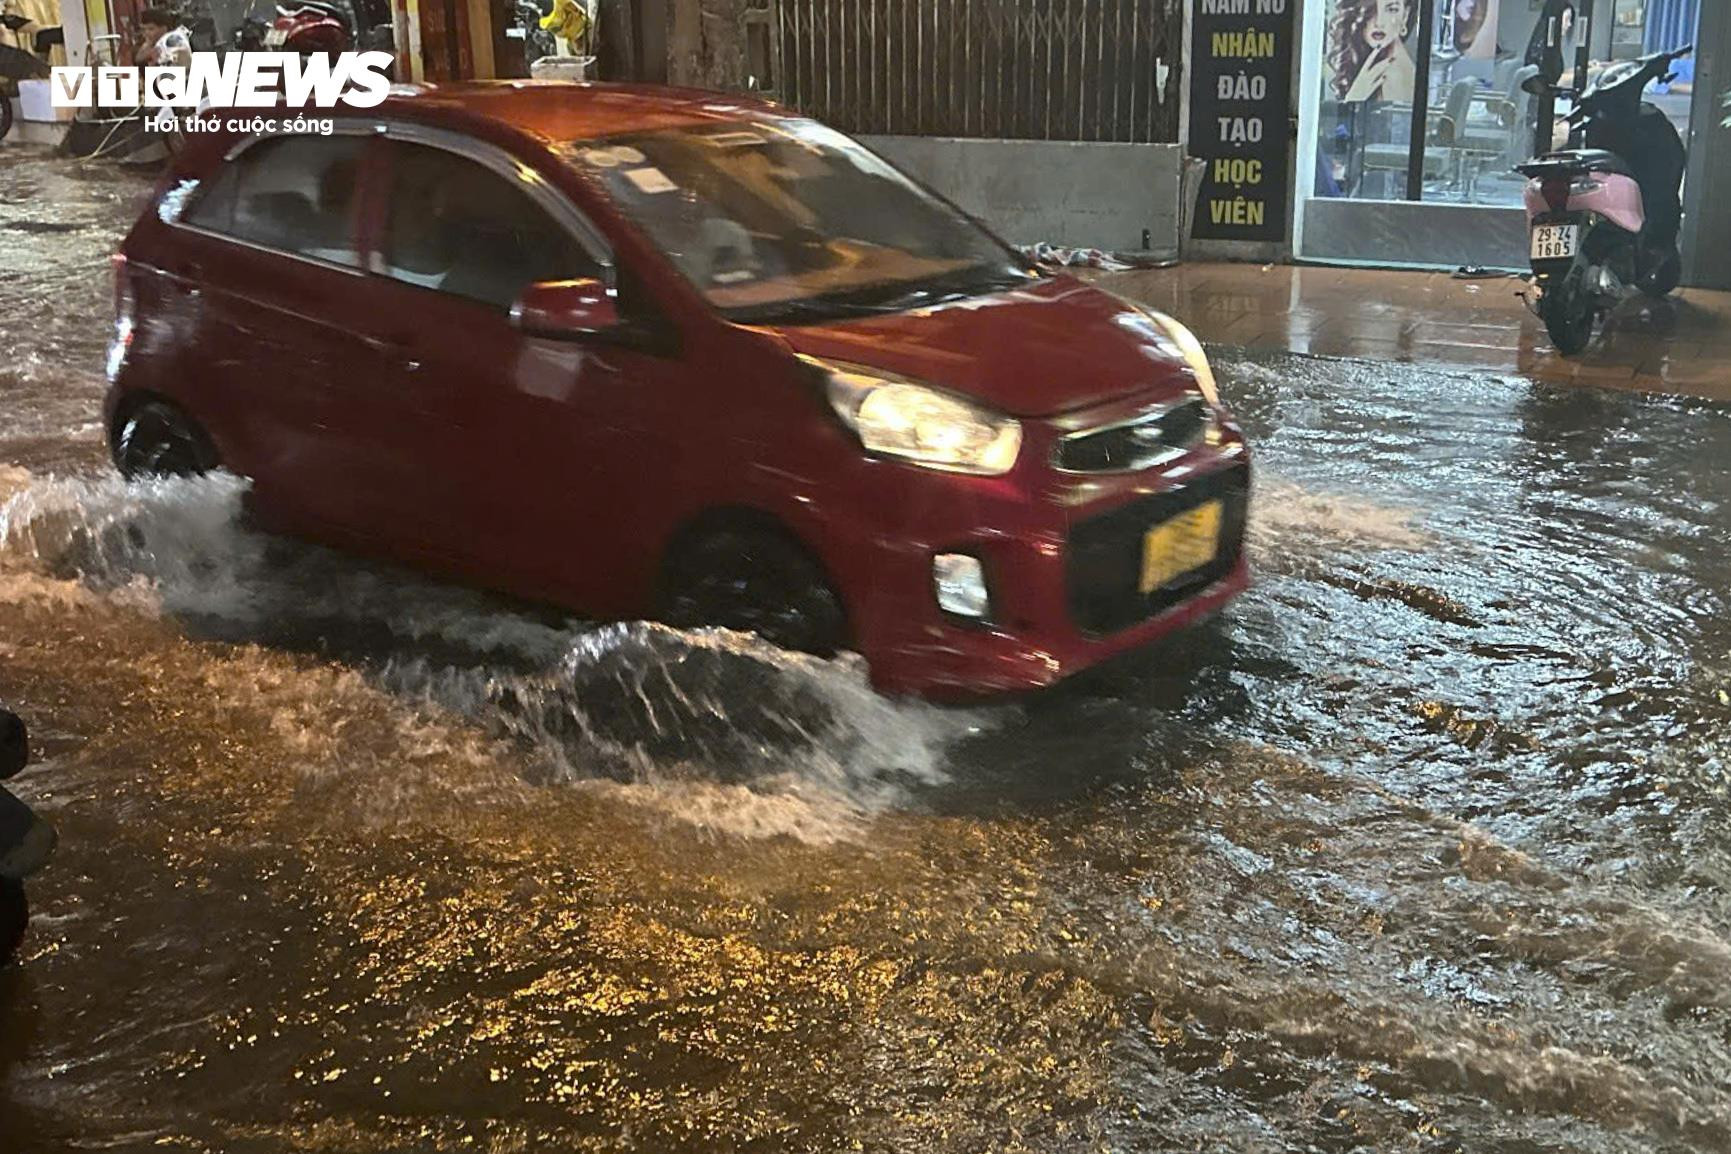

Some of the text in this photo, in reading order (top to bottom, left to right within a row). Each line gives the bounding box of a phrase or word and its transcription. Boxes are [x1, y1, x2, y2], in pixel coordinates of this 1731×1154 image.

[1212, 27, 1275, 62] NHẬN
[1217, 70, 1267, 101] ĐÀO
[1218, 118, 1264, 147] TẠO
[1214, 159, 1262, 189] HỌC
[1210, 196, 1265, 225] VIÊN
[1537, 242, 1571, 256] 1605
